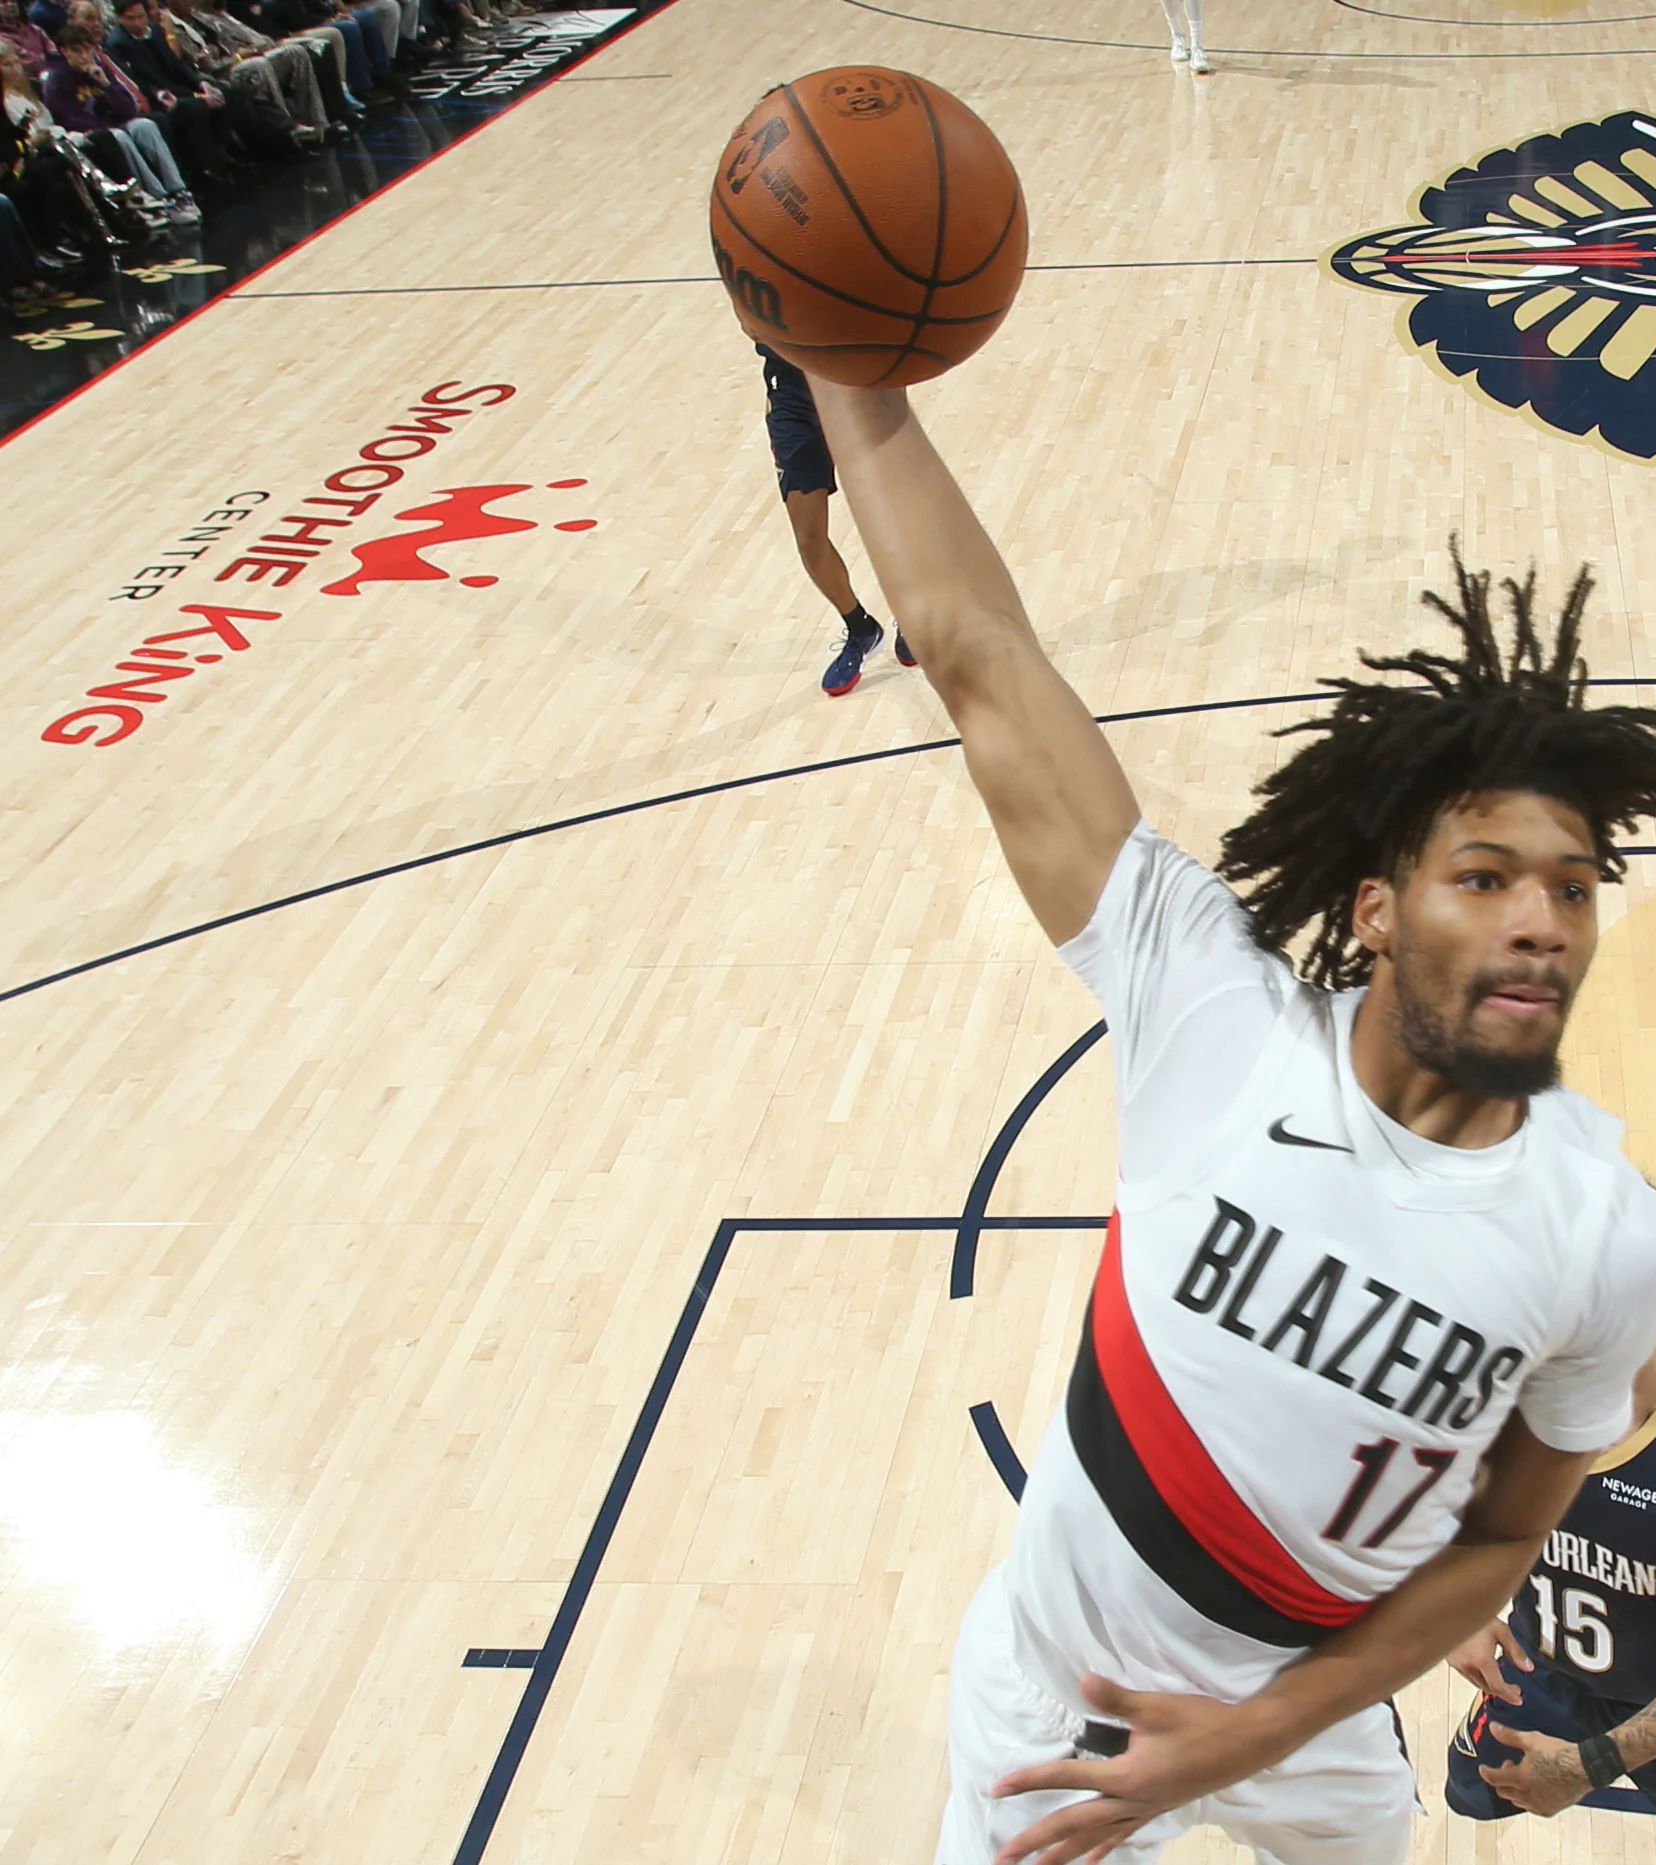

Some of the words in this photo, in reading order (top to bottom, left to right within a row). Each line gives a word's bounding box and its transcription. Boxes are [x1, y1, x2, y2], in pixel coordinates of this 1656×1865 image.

[212, 380, 517, 588] SMOOTHIE
[108, 490, 271, 602] CENTER
[1170, 1192, 1526, 1430] BLAZERS
[1319, 1435, 1461, 1549] 17
[1610, 1492, 1648, 1511] GARAGE
[1528, 1573, 1615, 1674] 15
